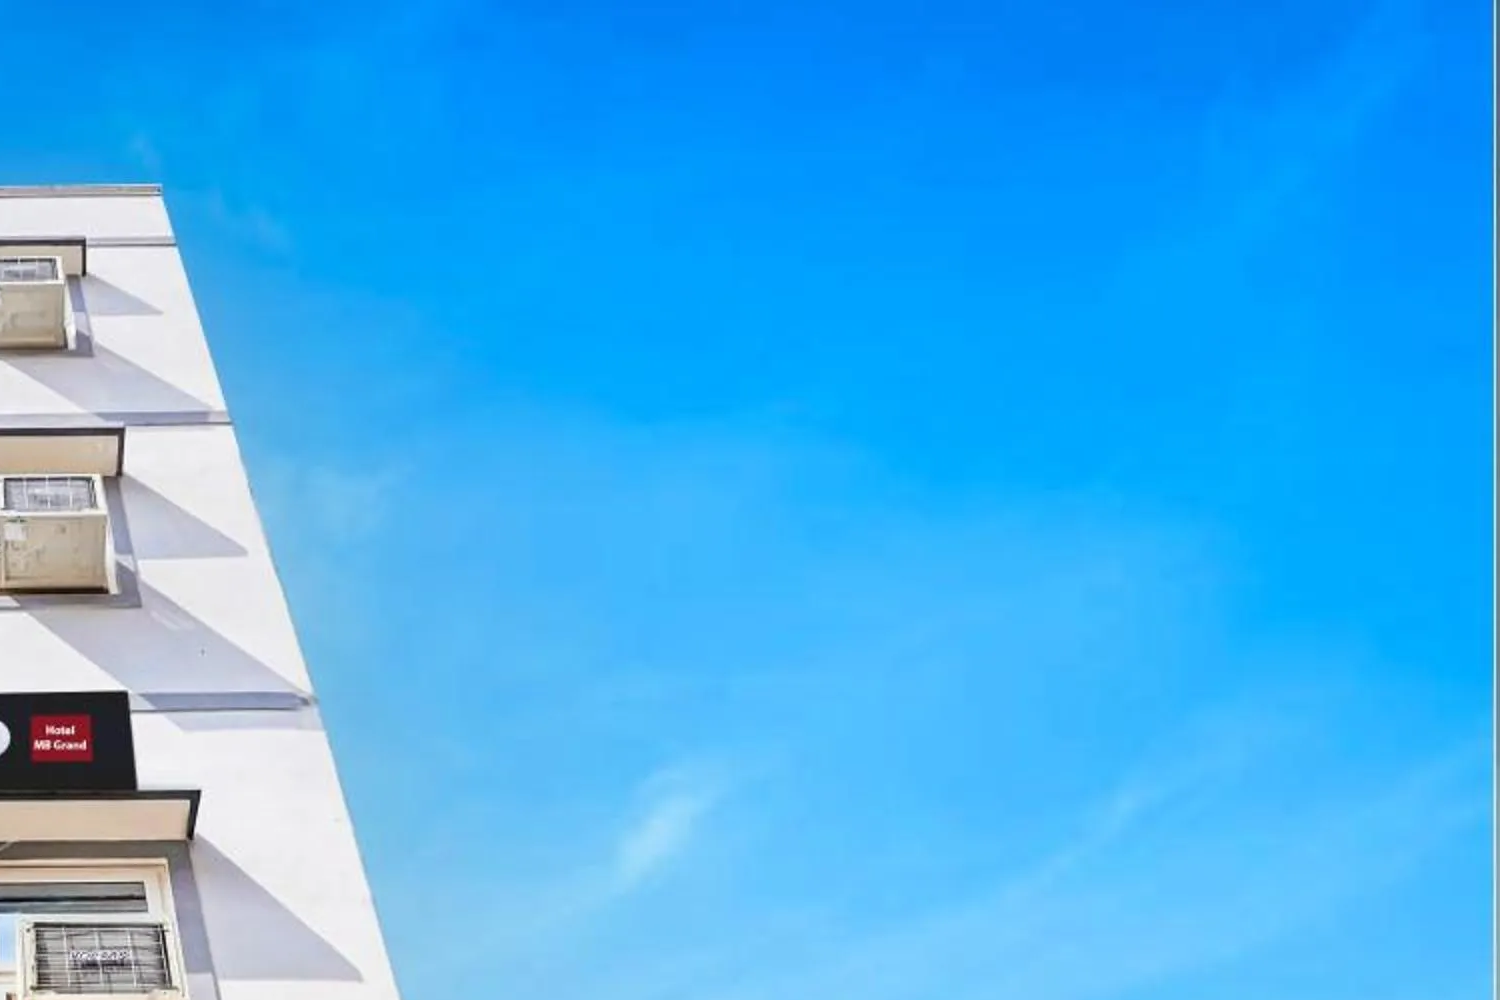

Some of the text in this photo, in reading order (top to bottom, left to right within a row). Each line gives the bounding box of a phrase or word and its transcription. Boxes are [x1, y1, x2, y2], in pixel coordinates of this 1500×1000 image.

[45, 724, 75, 735] Hotel
[34, 740, 87, 751] MB Grand
